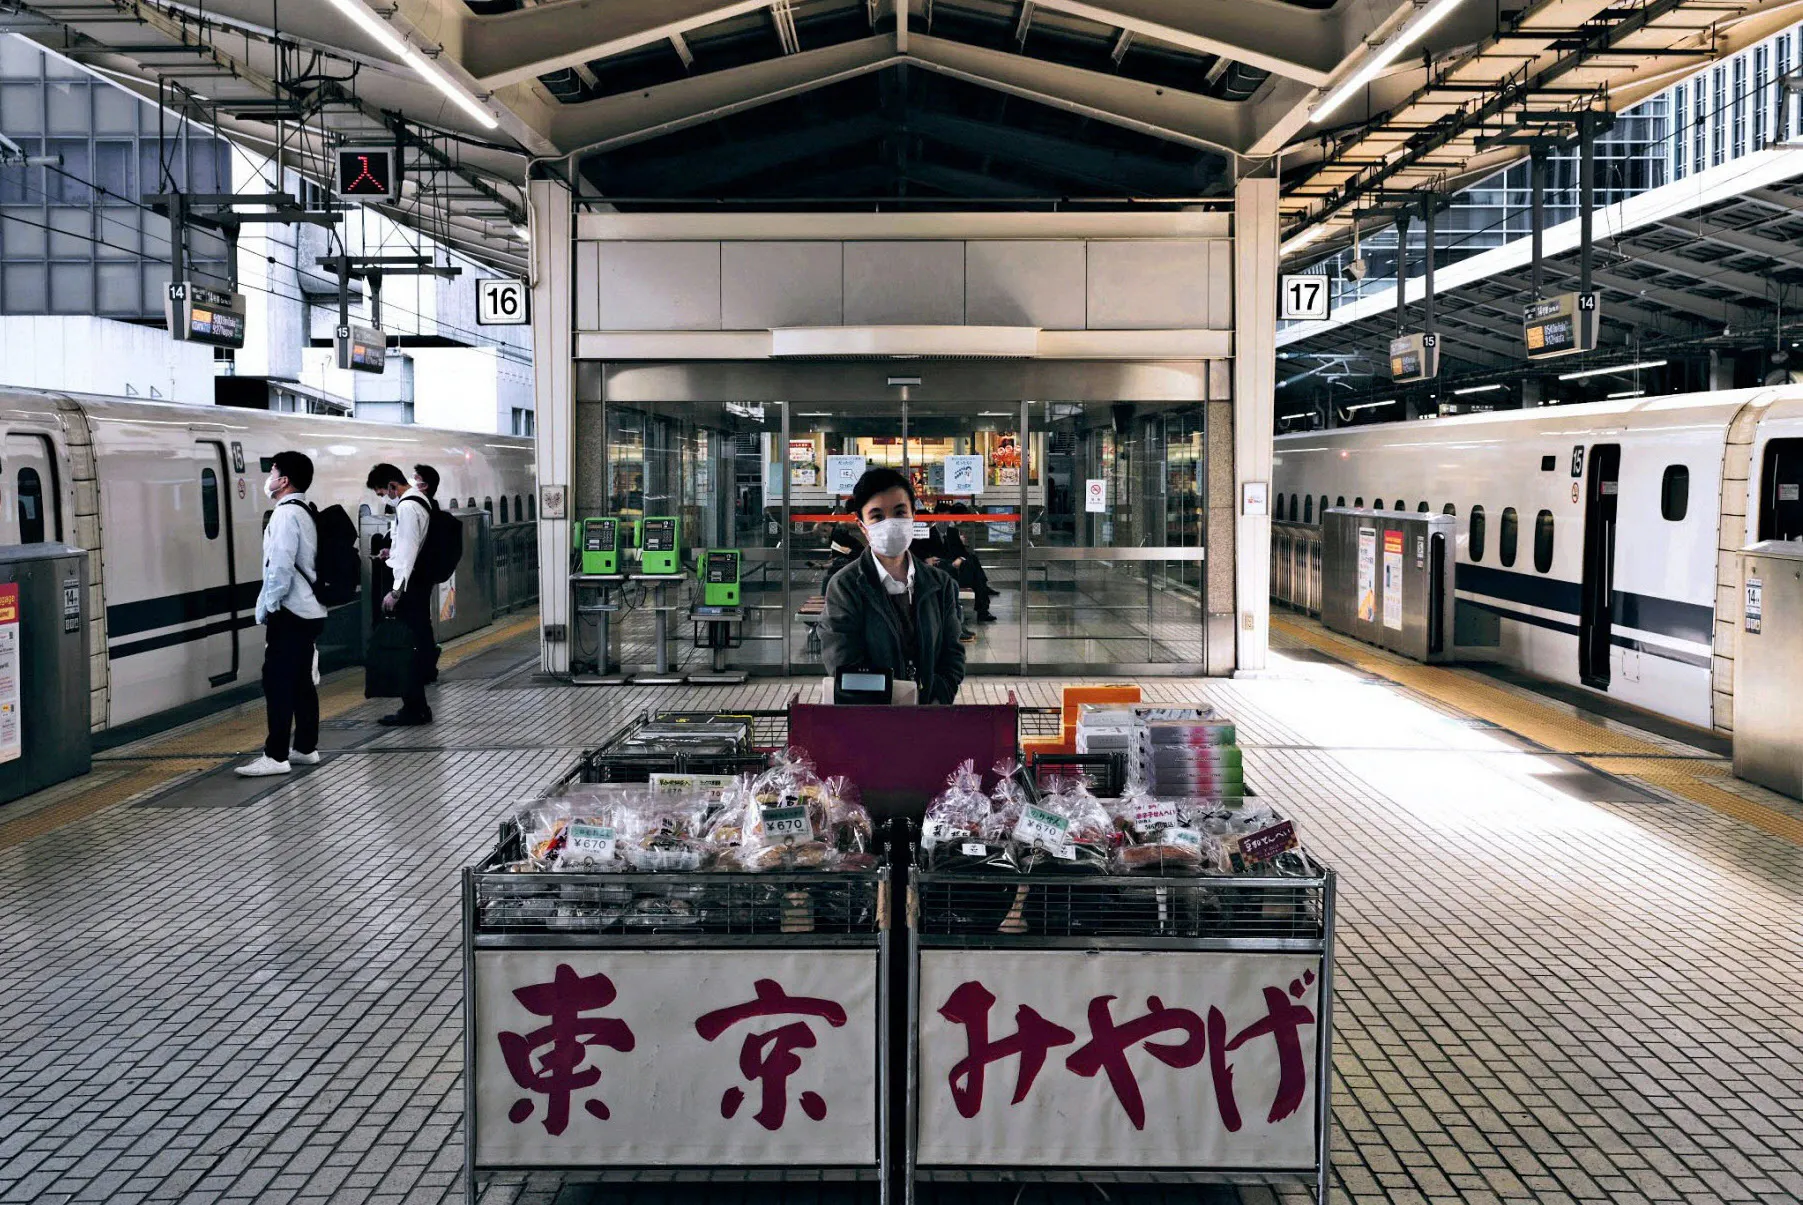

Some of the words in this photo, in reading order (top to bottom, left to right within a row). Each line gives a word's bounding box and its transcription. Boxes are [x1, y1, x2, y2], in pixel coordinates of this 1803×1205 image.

[170, 286, 184, 299] 14
[1290, 284, 1320, 311] 17
[487, 288, 517, 315] 16
[1580, 296, 1594, 309] 14
[337, 327, 348, 337] 15
[1424, 336, 1434, 346] 15
[232, 445, 244, 469] 15
[1572, 449, 1582, 476] 15
[65, 590, 74, 606] 14
[1748, 589, 1756, 605] 14
[766, 819, 802, 831] ¥670
[1027, 819, 1057, 836] ¥670
[574, 838, 606, 849] ¥670
[497, 963, 847, 1137] 東京
[937, 968, 1316, 1133] みやげ
